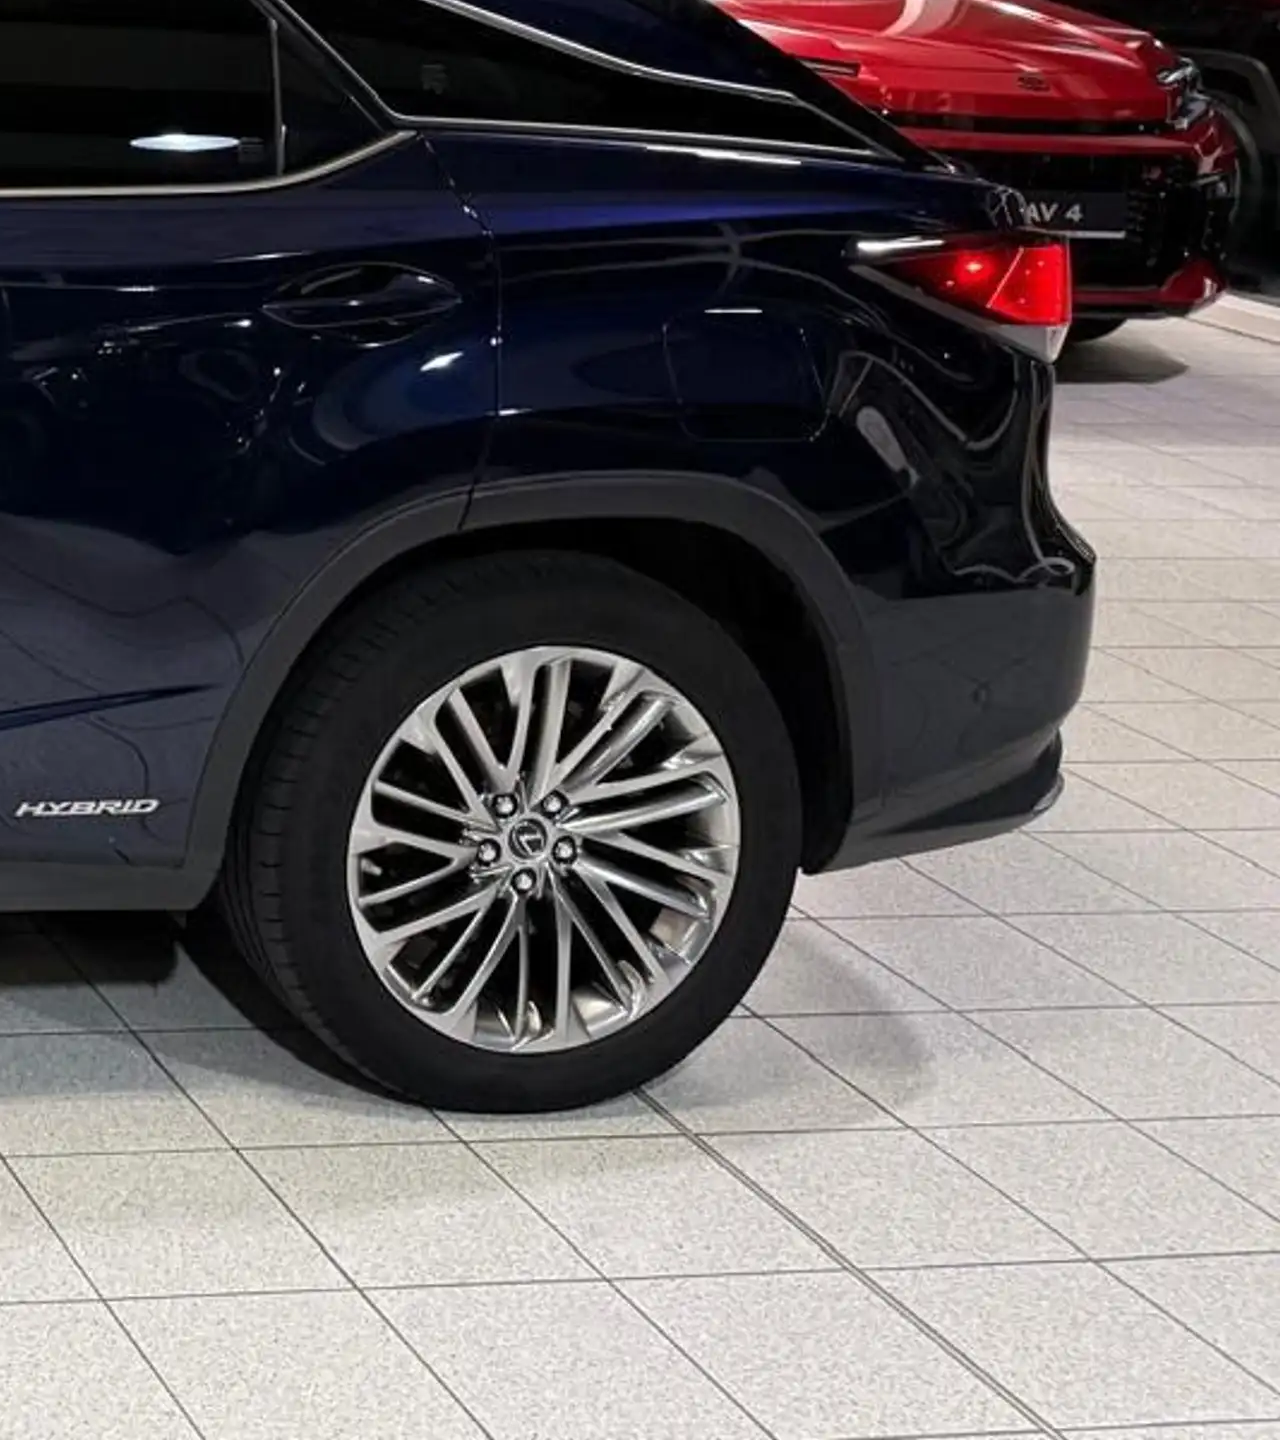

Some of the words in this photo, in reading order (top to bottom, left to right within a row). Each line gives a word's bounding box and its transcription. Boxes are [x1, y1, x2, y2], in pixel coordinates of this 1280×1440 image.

[1024, 202, 1058, 222] AV
[1065, 203, 1083, 222] 4
[15, 798, 160, 817] HYBRID
